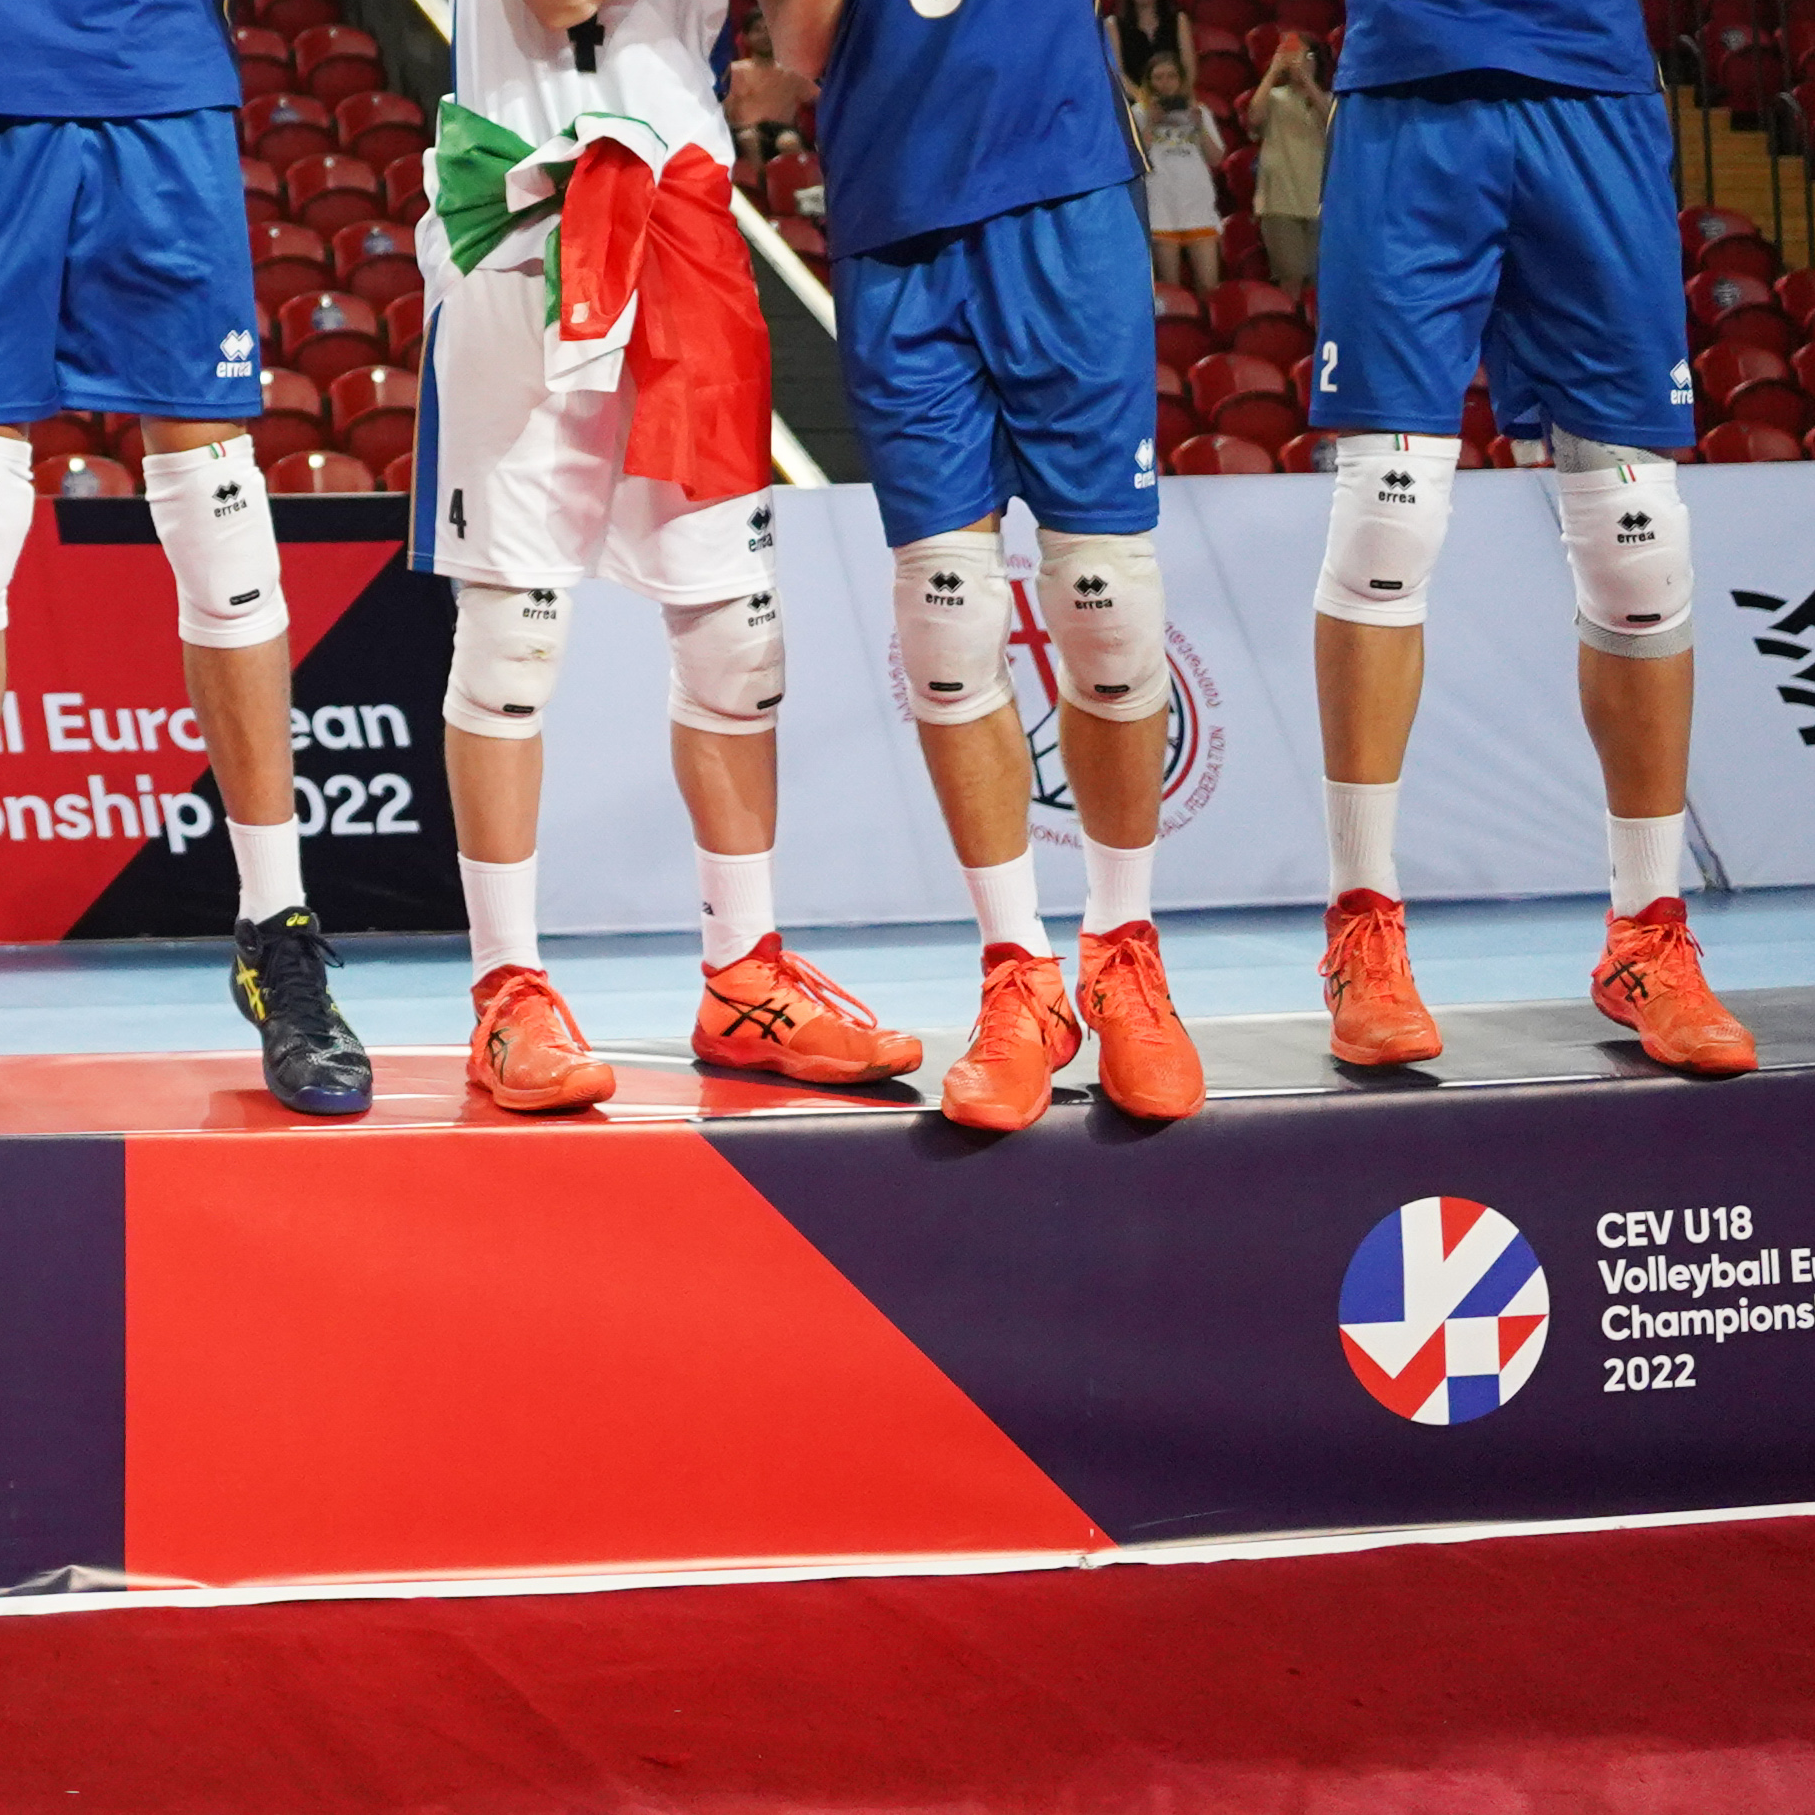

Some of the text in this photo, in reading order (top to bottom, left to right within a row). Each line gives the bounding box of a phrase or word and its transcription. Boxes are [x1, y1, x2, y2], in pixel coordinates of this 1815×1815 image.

[215, 360, 253, 378] errea
[1320, 341, 1338, 393] 2
[1377, 490, 1416, 504] errea
[213, 499, 248, 518] errea
[449, 488, 467, 540] 4
[1616, 531, 1655, 545] errea
[925, 593, 965, 607] errea
[1075, 598, 1113, 611] errea
[522, 607, 557, 620] errea
[1596, 1205, 1754, 1249] CEV U18
[1597, 1248, 1781, 1299] Volleyball
[1601, 1295, 1815, 1344] Champions
[1603, 1353, 1697, 1393] 2022
